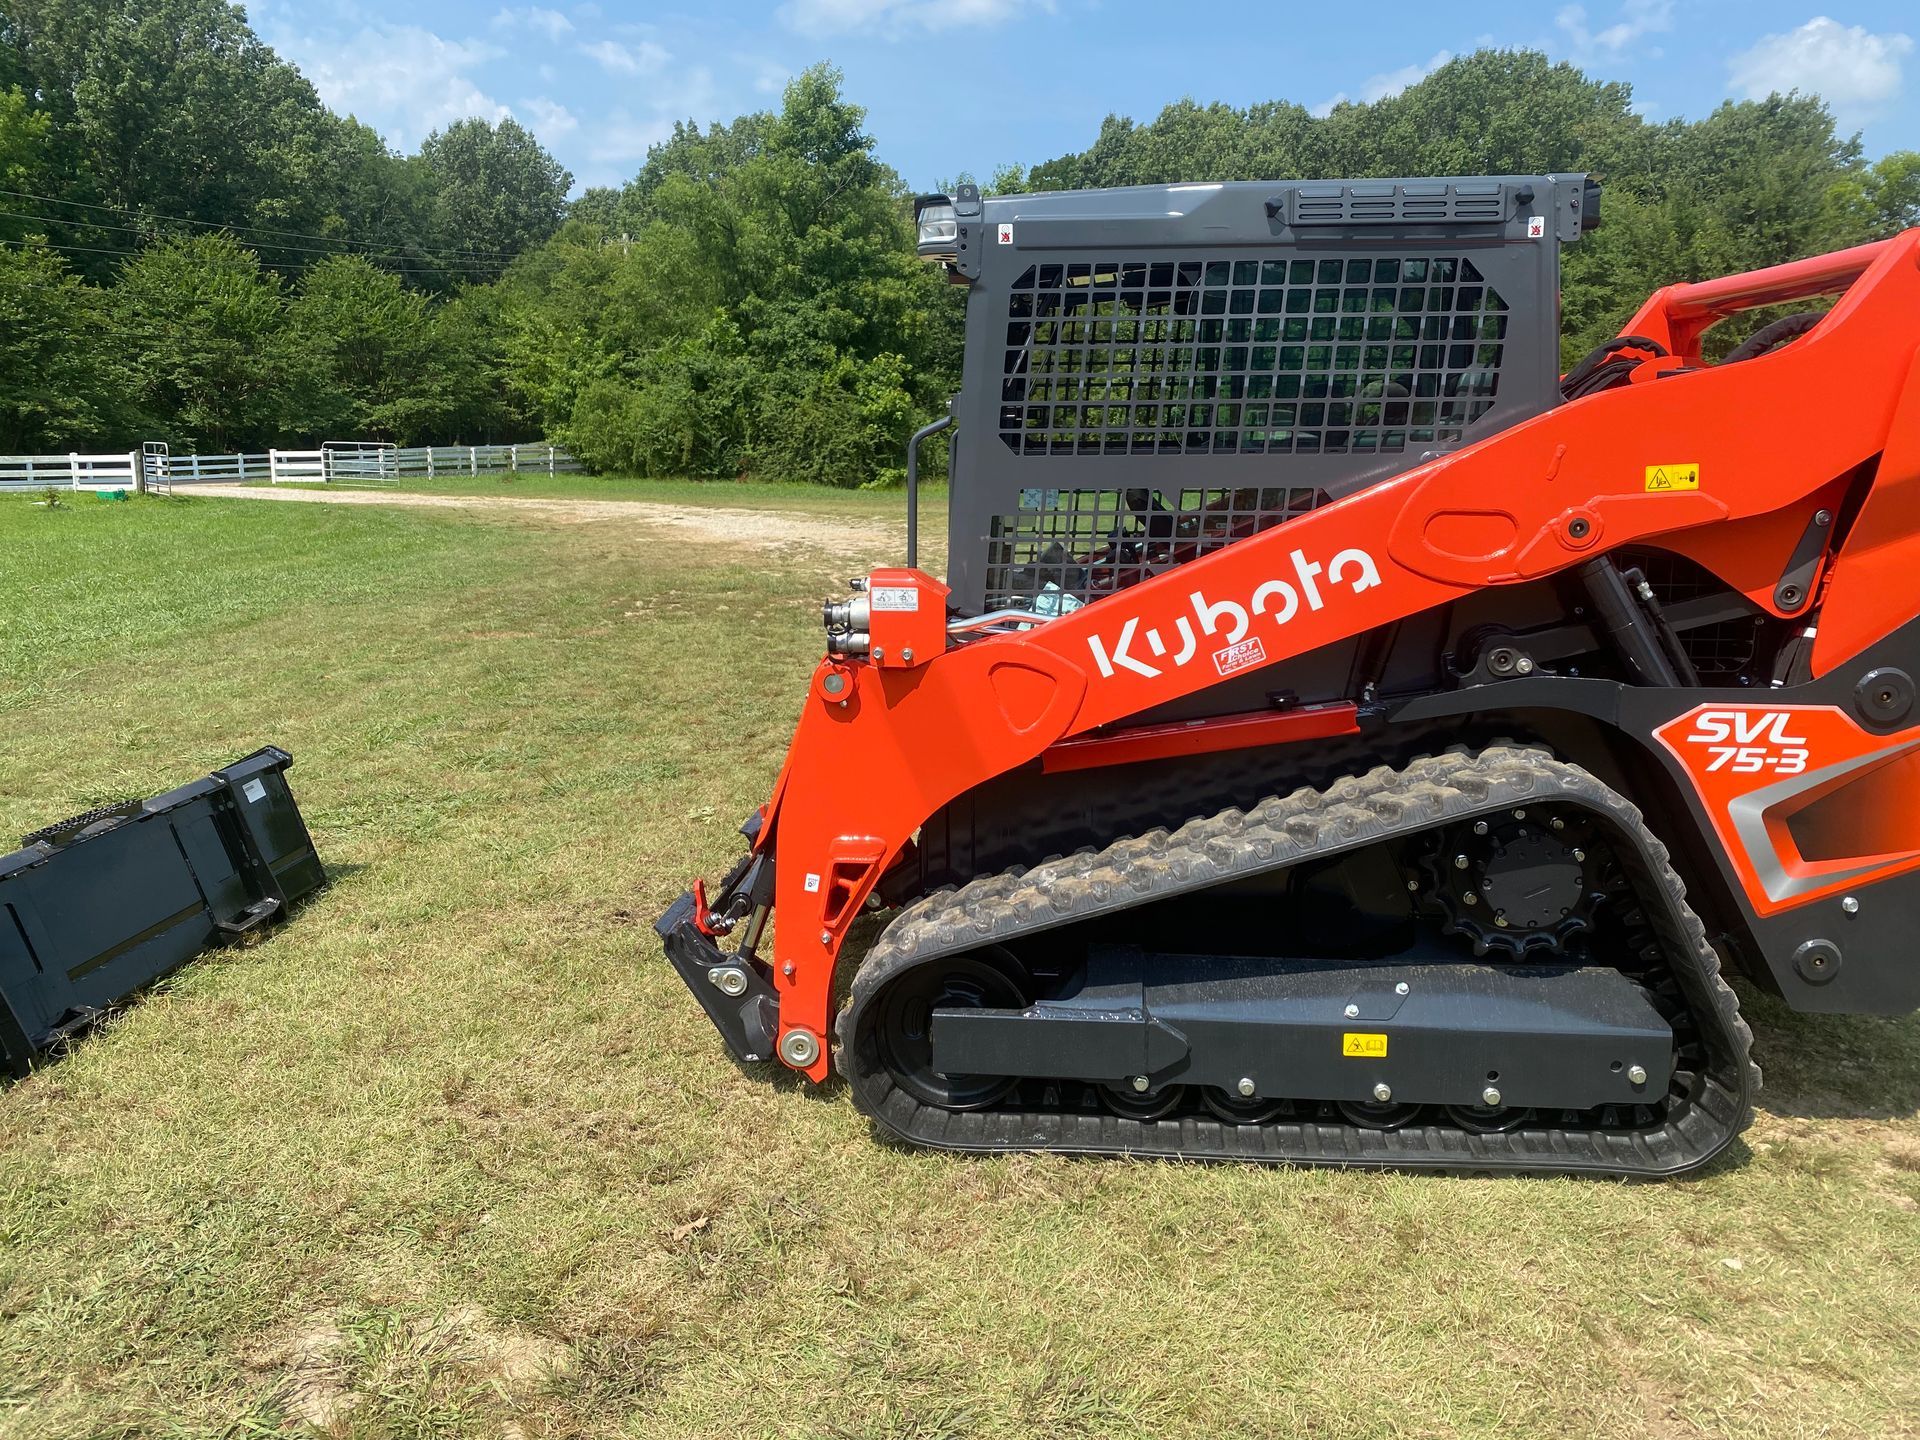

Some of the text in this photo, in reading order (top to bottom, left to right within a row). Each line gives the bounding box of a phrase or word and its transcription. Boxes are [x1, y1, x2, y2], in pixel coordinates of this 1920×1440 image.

[1087, 548, 1382, 678] Kubota
[1220, 640, 1255, 663] FIRST
[1687, 712, 1807, 745] SVL
[1705, 747, 1809, 774] 75-3
